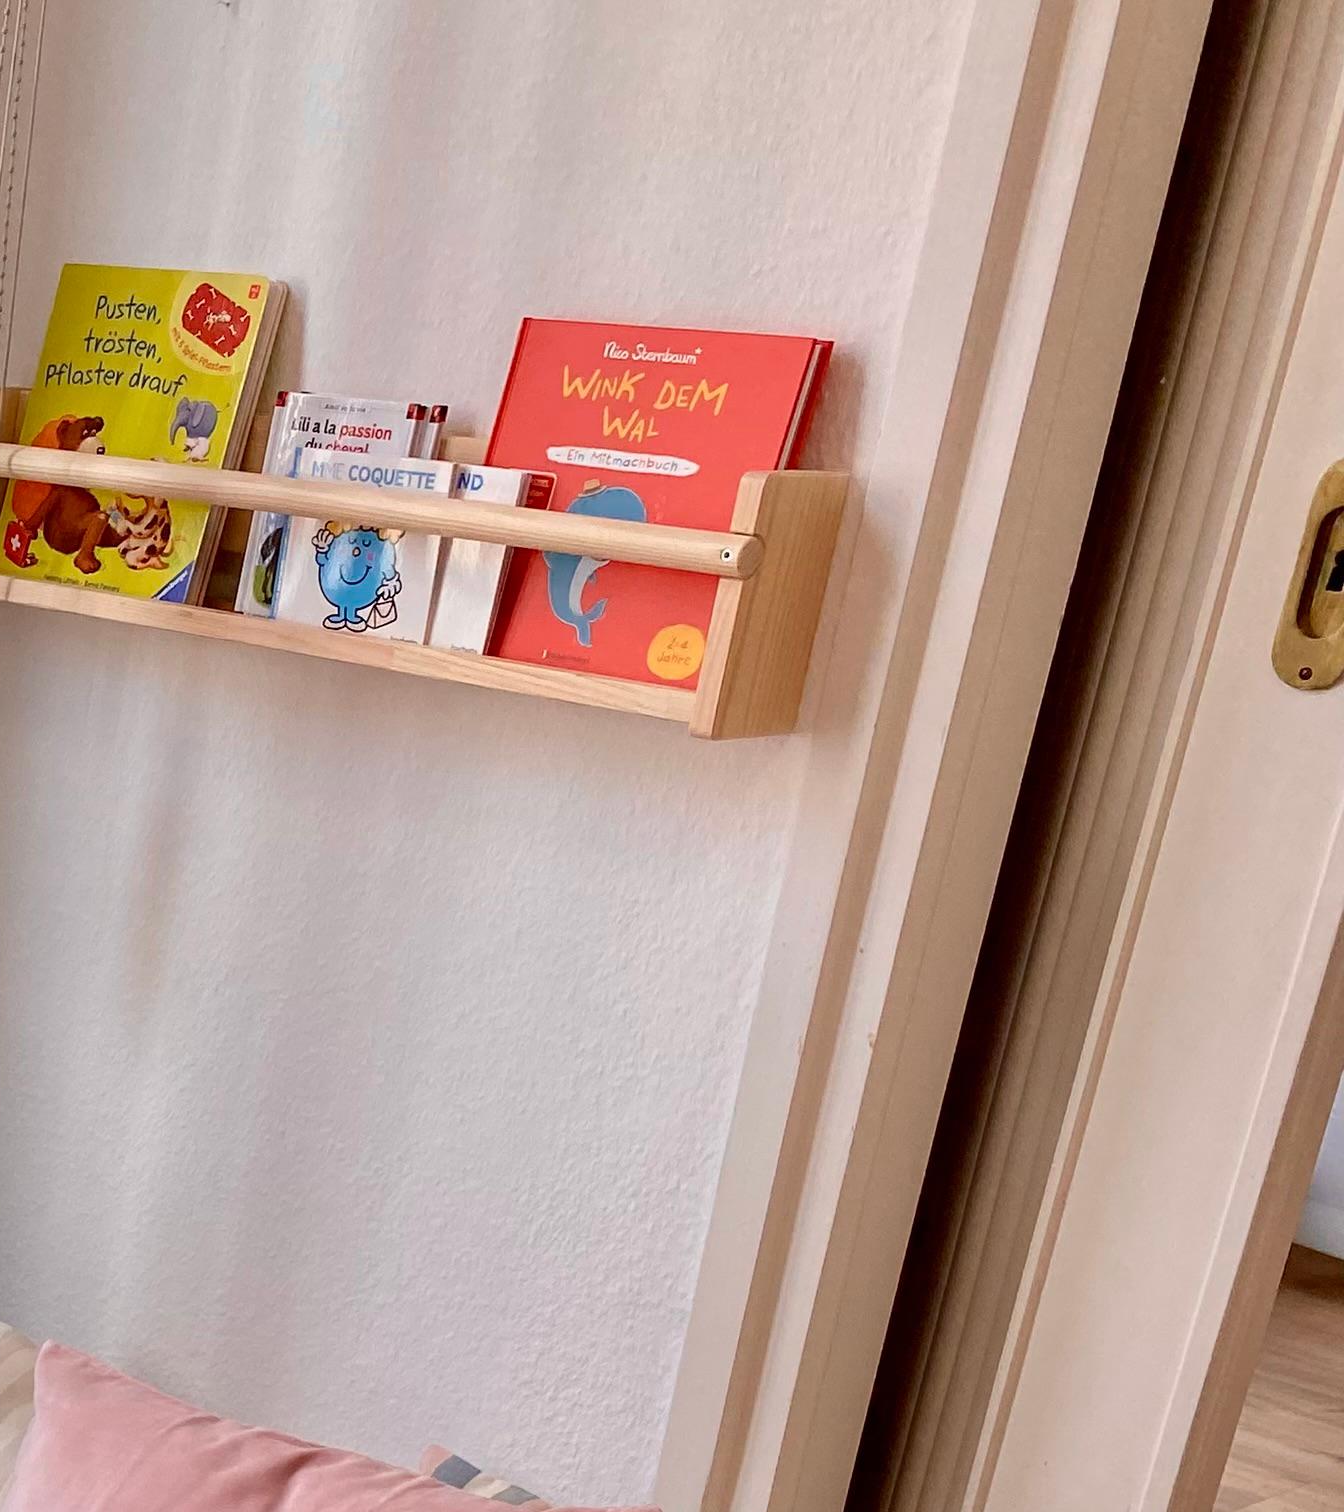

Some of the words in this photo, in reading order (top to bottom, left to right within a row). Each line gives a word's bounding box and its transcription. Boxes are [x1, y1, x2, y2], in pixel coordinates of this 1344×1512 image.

[94, 295, 162, 324] Pusten,
[83, 327, 163, 363] trösten,
[602, 341, 629, 360] Nico
[632, 343, 697, 365] Sternbaum
[44, 361, 124, 389] Pflaster
[128, 363, 188, 398] drauf
[562, 364, 646, 403] WINK
[653, 378, 729, 417] DEM
[292, 416, 311, 432] Lili
[312, 421, 321, 434] a
[324, 419, 337, 435] la
[338, 423, 392, 441] passion
[602, 405, 659, 443] WAL
[567, 449, 585, 462] Ein
[592, 451, 678, 472] Mitmachbuch
[348, 465, 436, 490] COQUETTE
